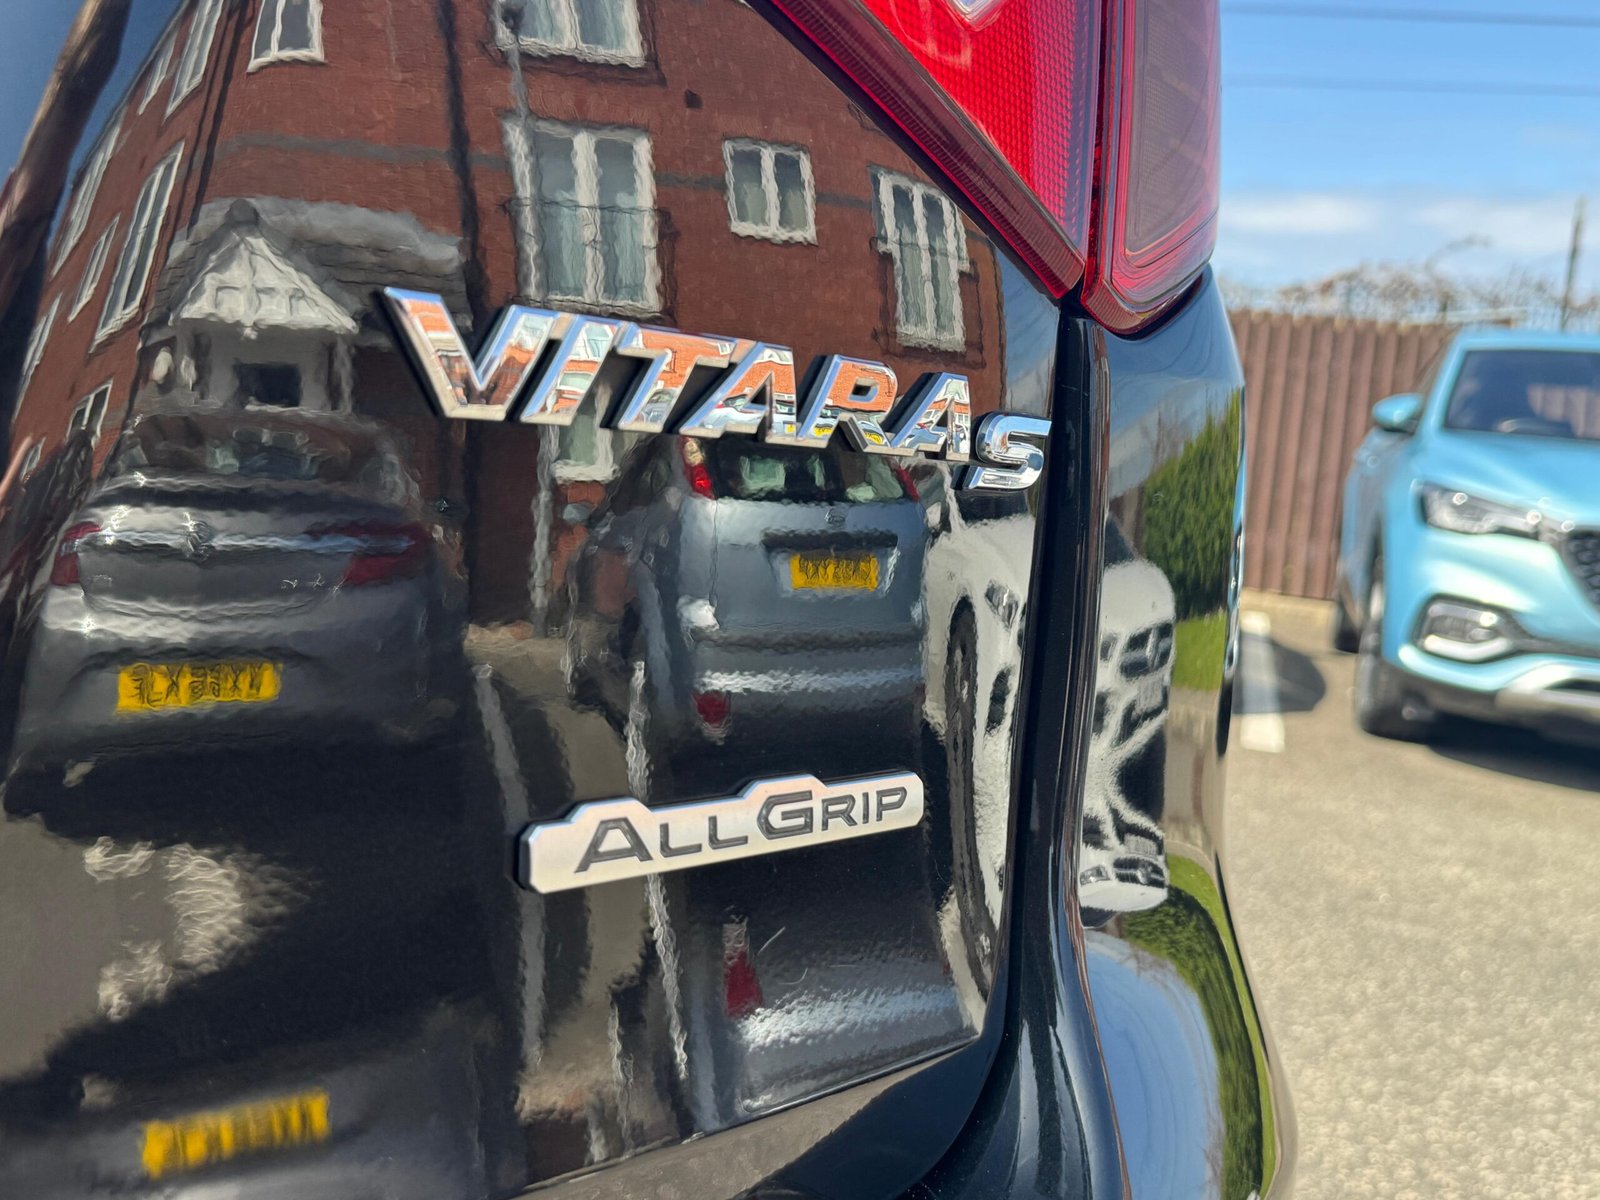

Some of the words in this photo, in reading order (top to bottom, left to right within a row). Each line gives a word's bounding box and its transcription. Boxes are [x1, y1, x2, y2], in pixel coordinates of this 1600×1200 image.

[384, 286, 972, 460] VITARA
[968, 411, 1052, 490] S
[573, 786, 908, 874] ALLGRIP
